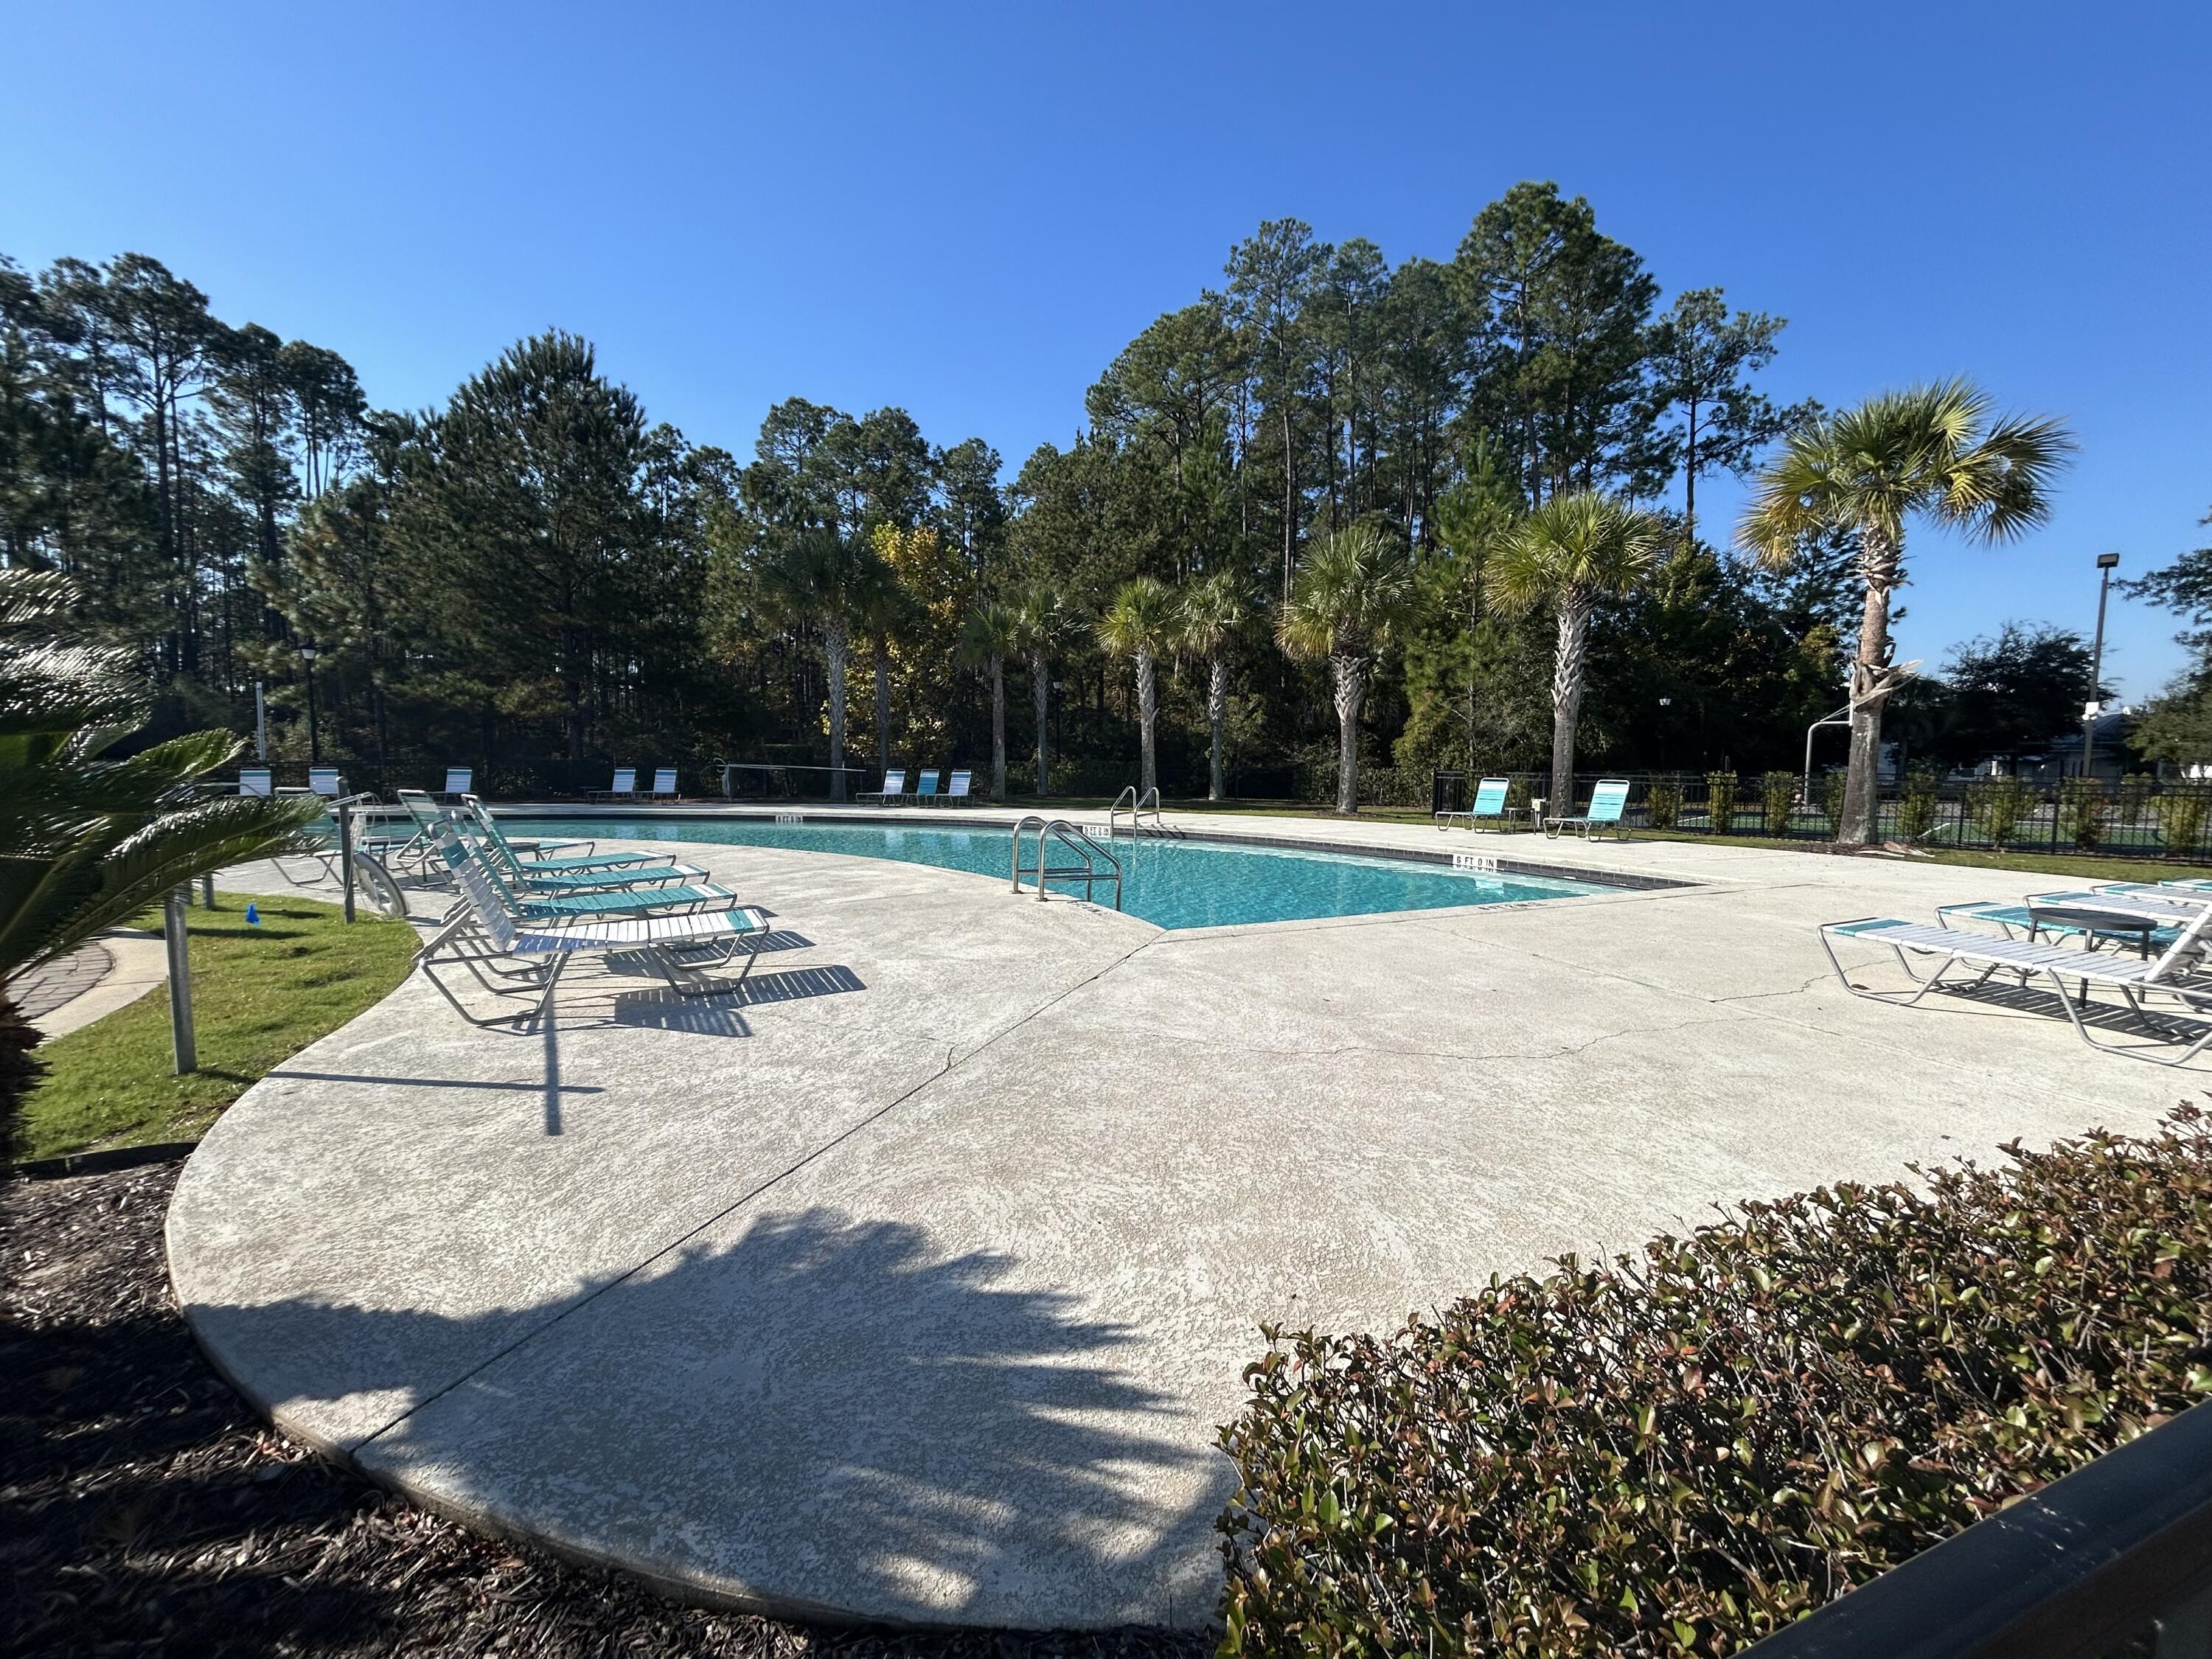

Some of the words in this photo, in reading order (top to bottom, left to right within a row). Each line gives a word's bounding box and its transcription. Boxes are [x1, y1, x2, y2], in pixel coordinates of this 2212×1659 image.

[1464, 856, 1474, 865] FT
[1478, 858, 1483, 866] 0
[1486, 858, 1494, 867] IN
